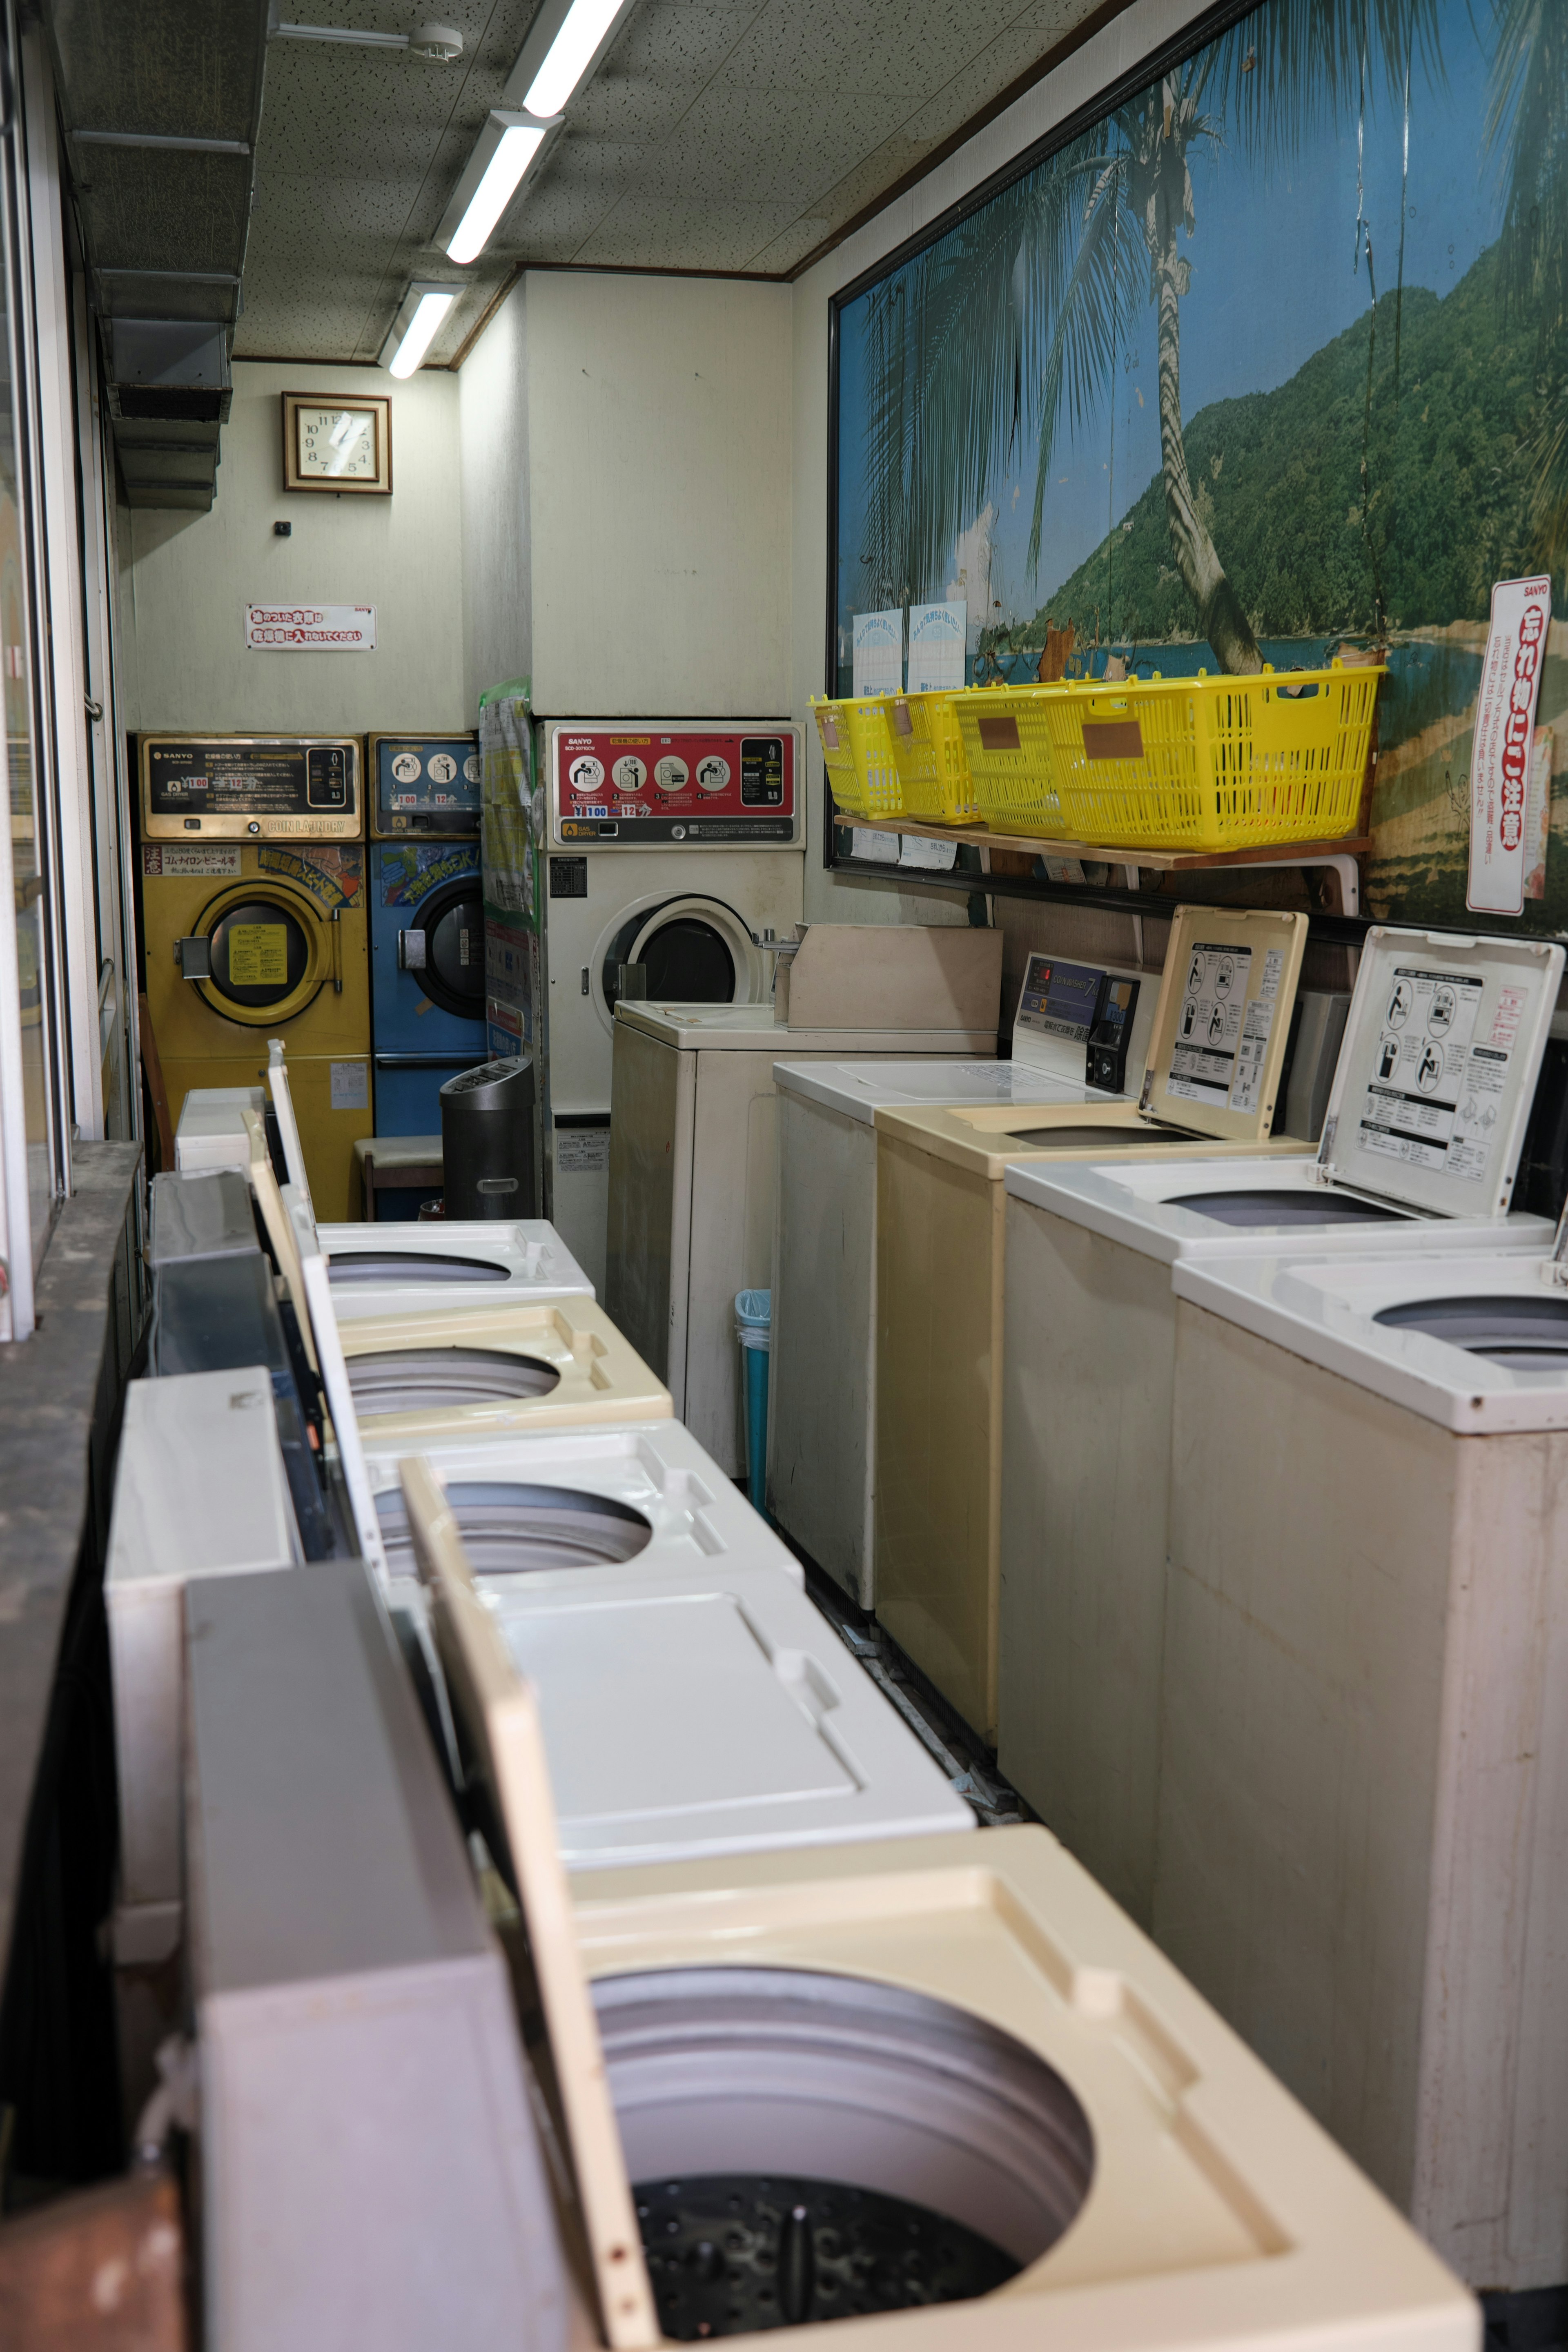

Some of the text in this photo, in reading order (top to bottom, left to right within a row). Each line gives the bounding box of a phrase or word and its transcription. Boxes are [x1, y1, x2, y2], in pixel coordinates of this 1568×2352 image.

[319, 416, 328, 425] 11
[331, 416, 342, 425] 12
[307, 425, 318, 434] 10
[305, 438, 314, 448] 9
[361, 441, 370, 450] 3
[308, 452, 317, 461] 8
[358, 454, 367, 464] 4
[321, 462, 328, 471] 7
[348, 463, 357, 472] 5
[1523, 584, 1548, 597] SANYO
[252, 610, 323, 624] 油のついた衣類は
[1501, 607, 1542, 847] 忘れ物にご注意
[268, 820, 345, 833] COIN LAUNDRY
[145, 846, 161, 874] 注意
[1053, 975, 1066, 986] COIN
[1066, 978, 1087, 989] WASHER
[1084, 977, 1096, 997] 7
[1020, 1015, 1031, 1023] SANYO
[1110, 1010, 1123, 1022] ¥300
